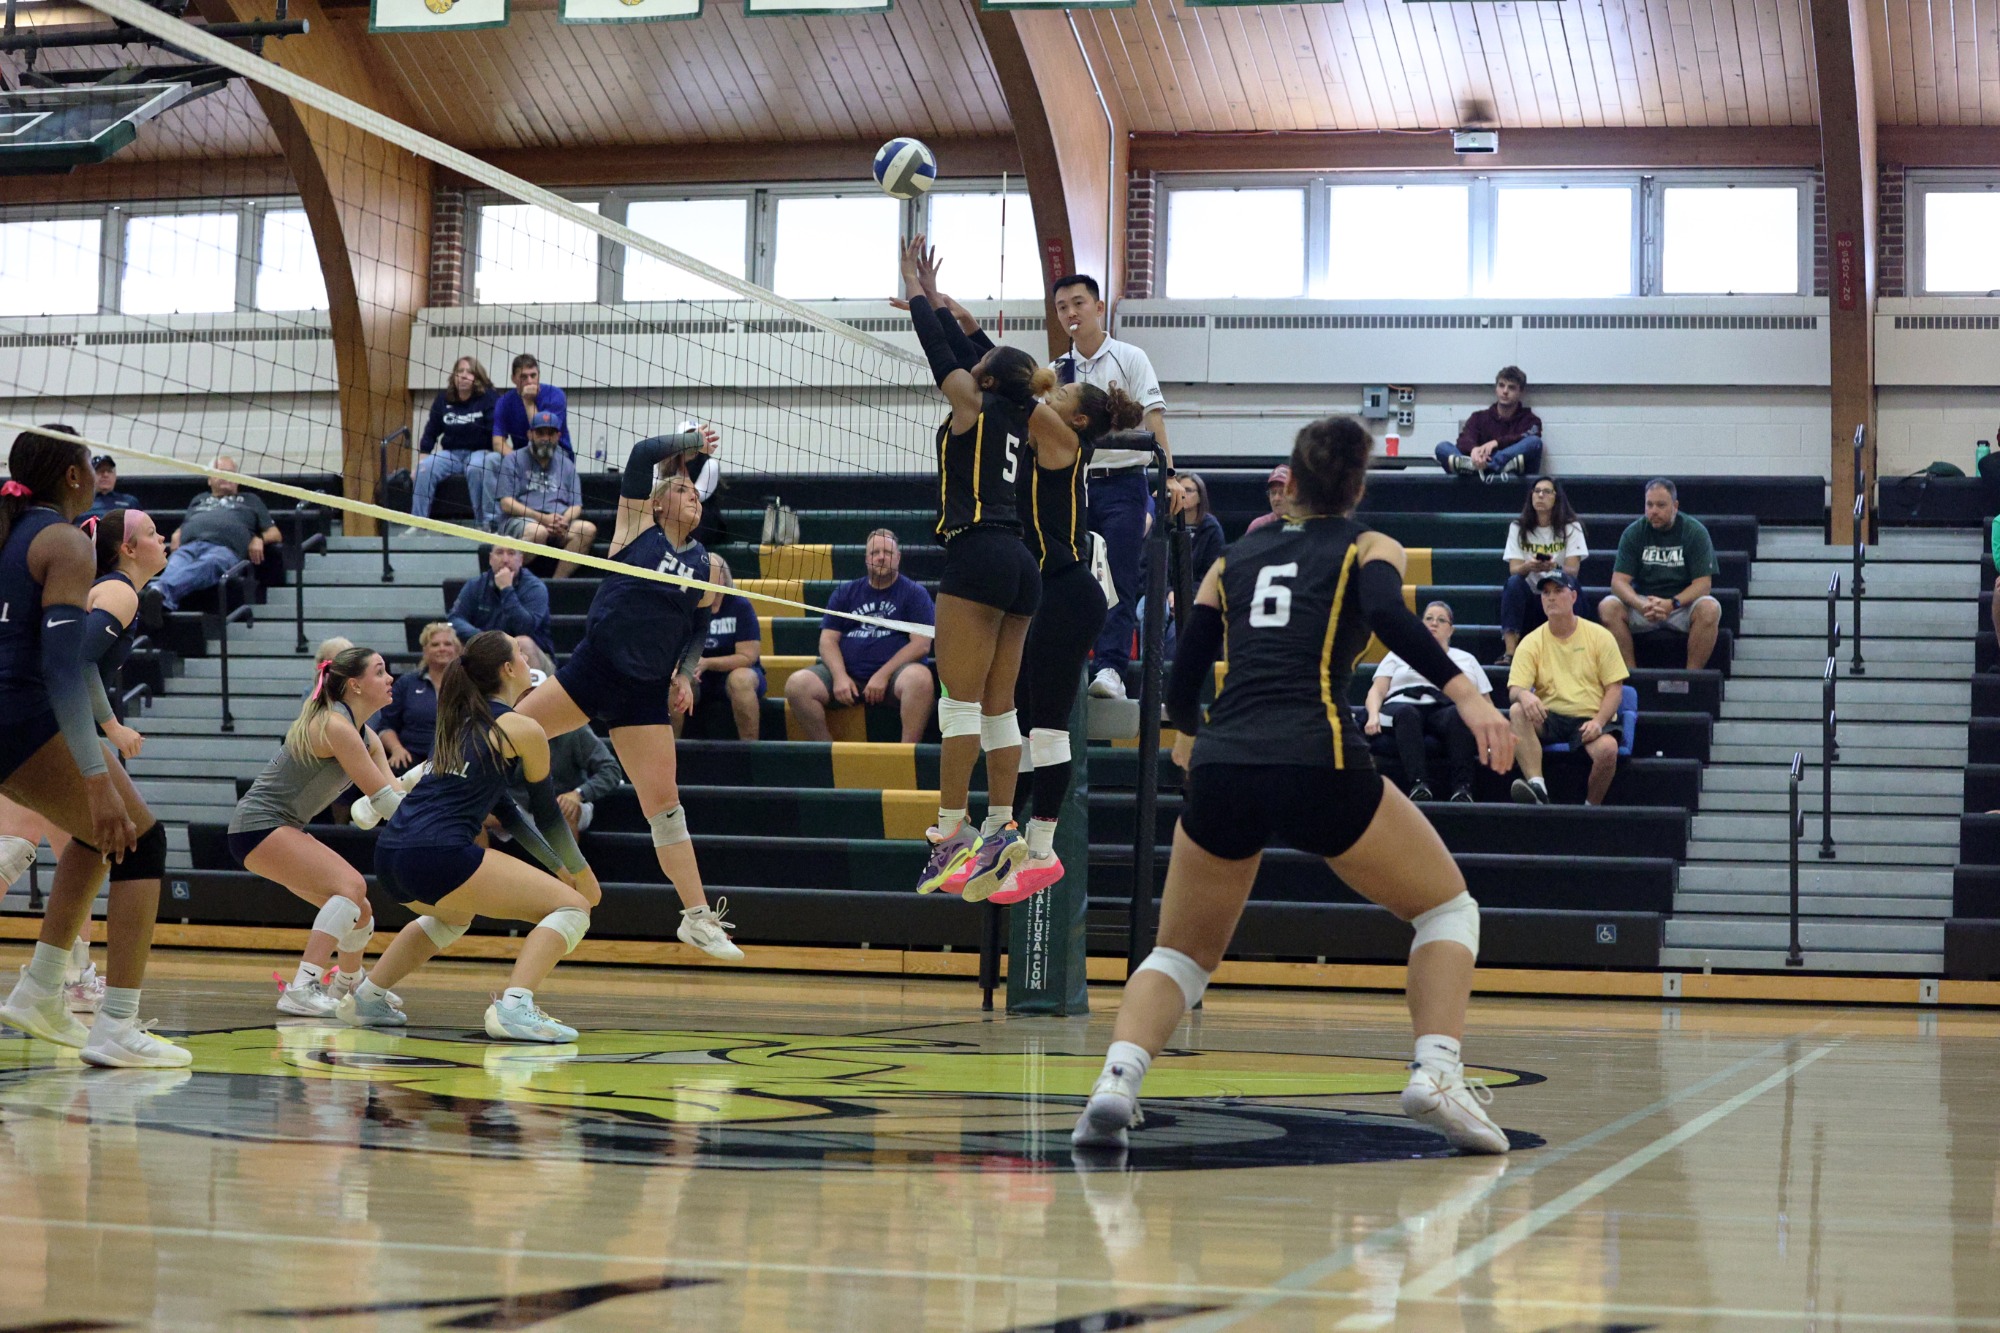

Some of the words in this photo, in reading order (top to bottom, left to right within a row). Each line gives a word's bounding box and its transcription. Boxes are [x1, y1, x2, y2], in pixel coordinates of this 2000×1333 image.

[1841, 251, 1851, 301] SMOKING
[1002, 432, 1020, 483] 5
[656, 551, 695, 594] 24
[1249, 562, 1298, 628] 6
